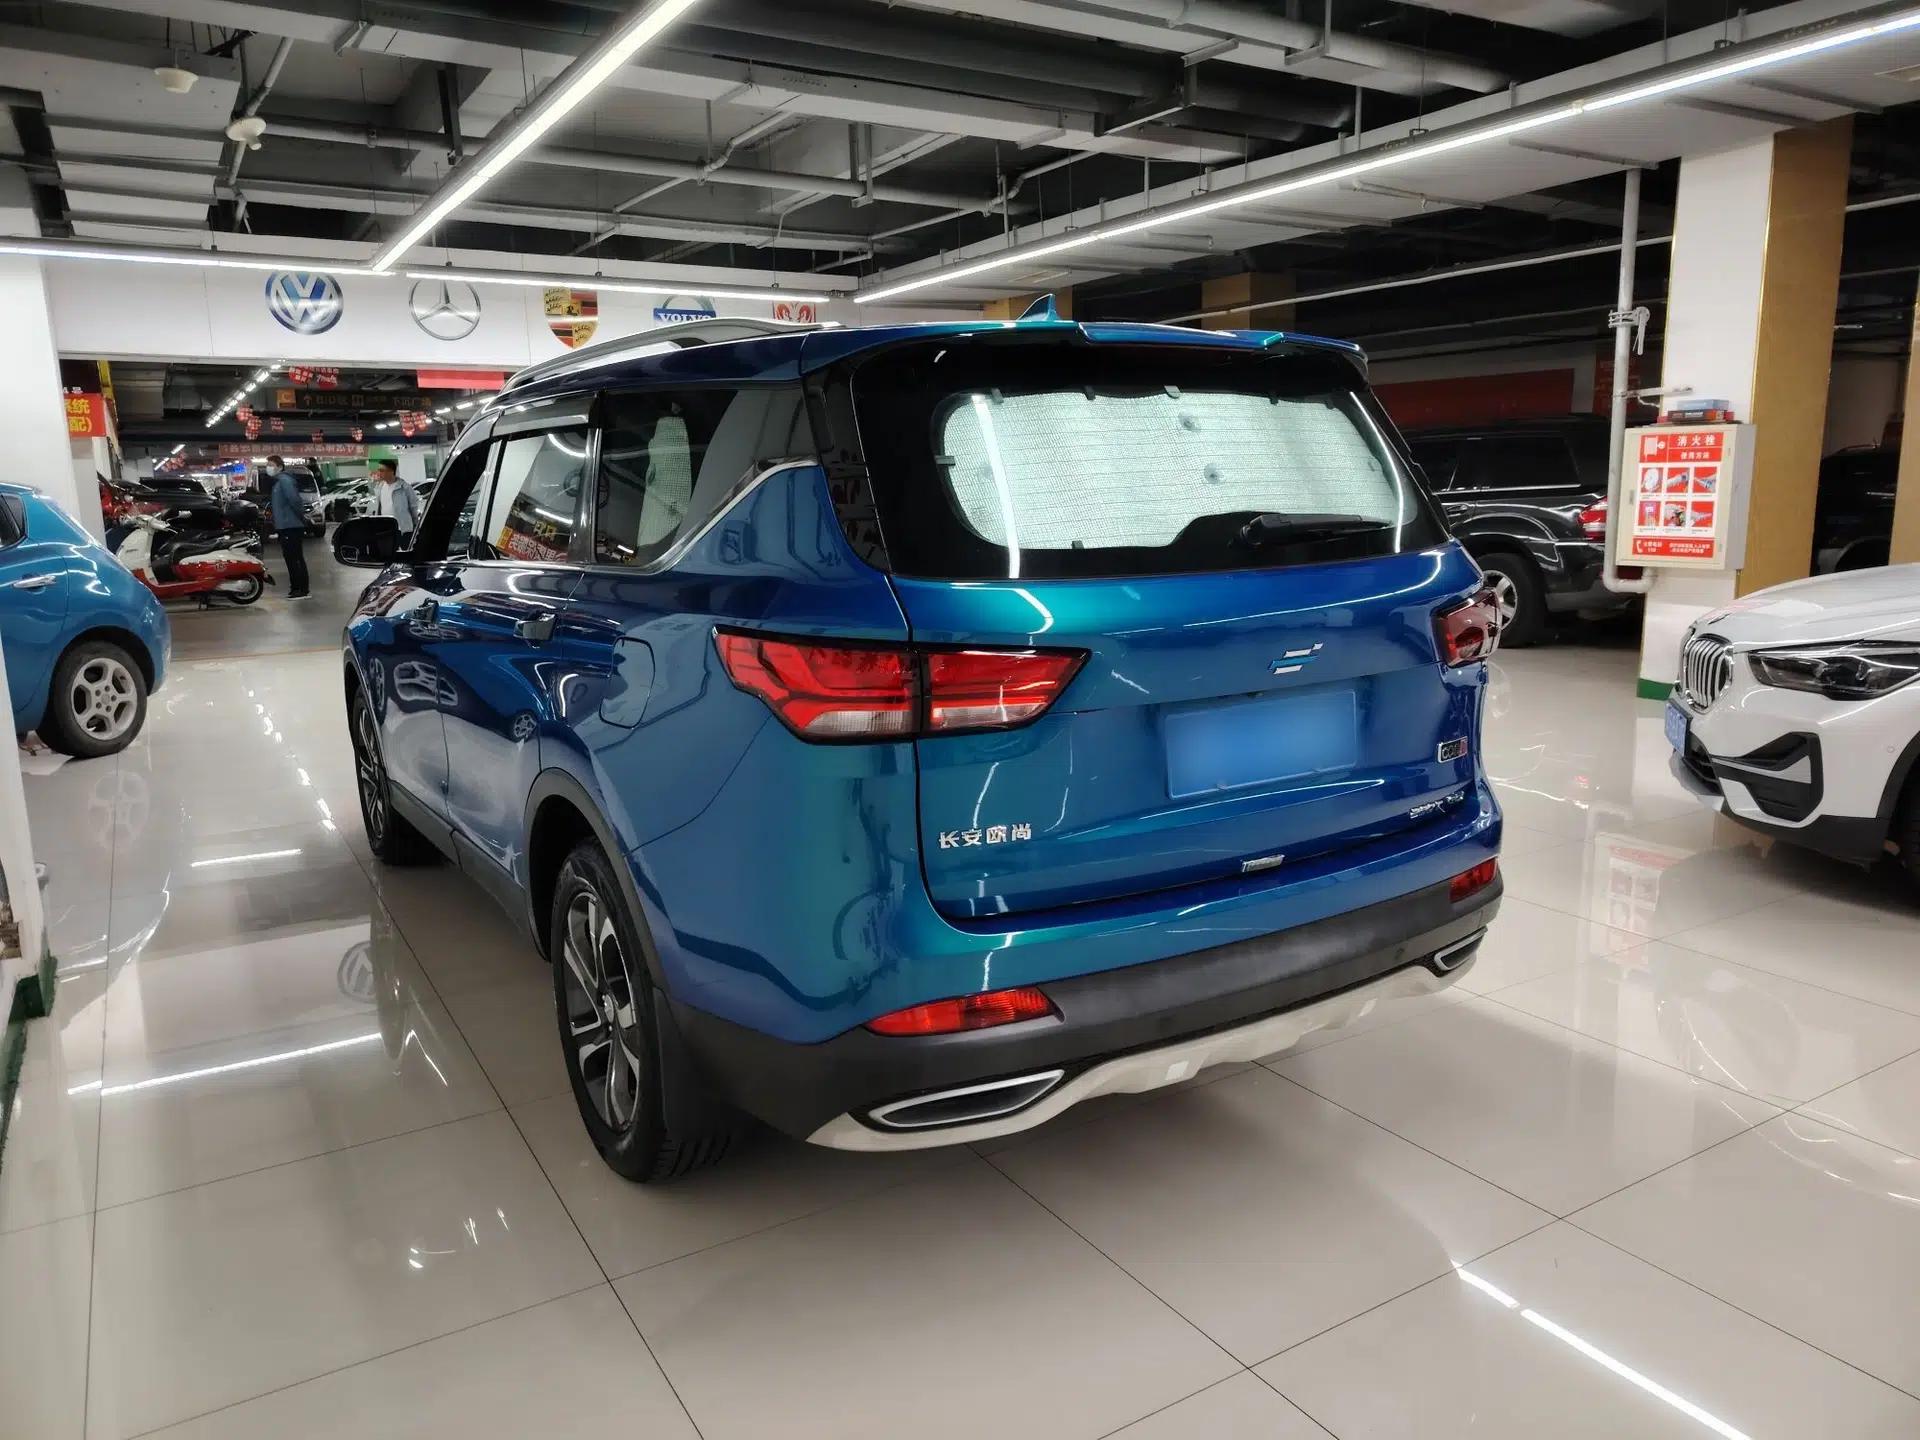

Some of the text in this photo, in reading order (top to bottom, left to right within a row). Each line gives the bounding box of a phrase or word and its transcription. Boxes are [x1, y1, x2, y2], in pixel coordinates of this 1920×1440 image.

[1677, 434, 1716, 447] 消火栓
[938, 823, 1032, 849] 长安欧尚
